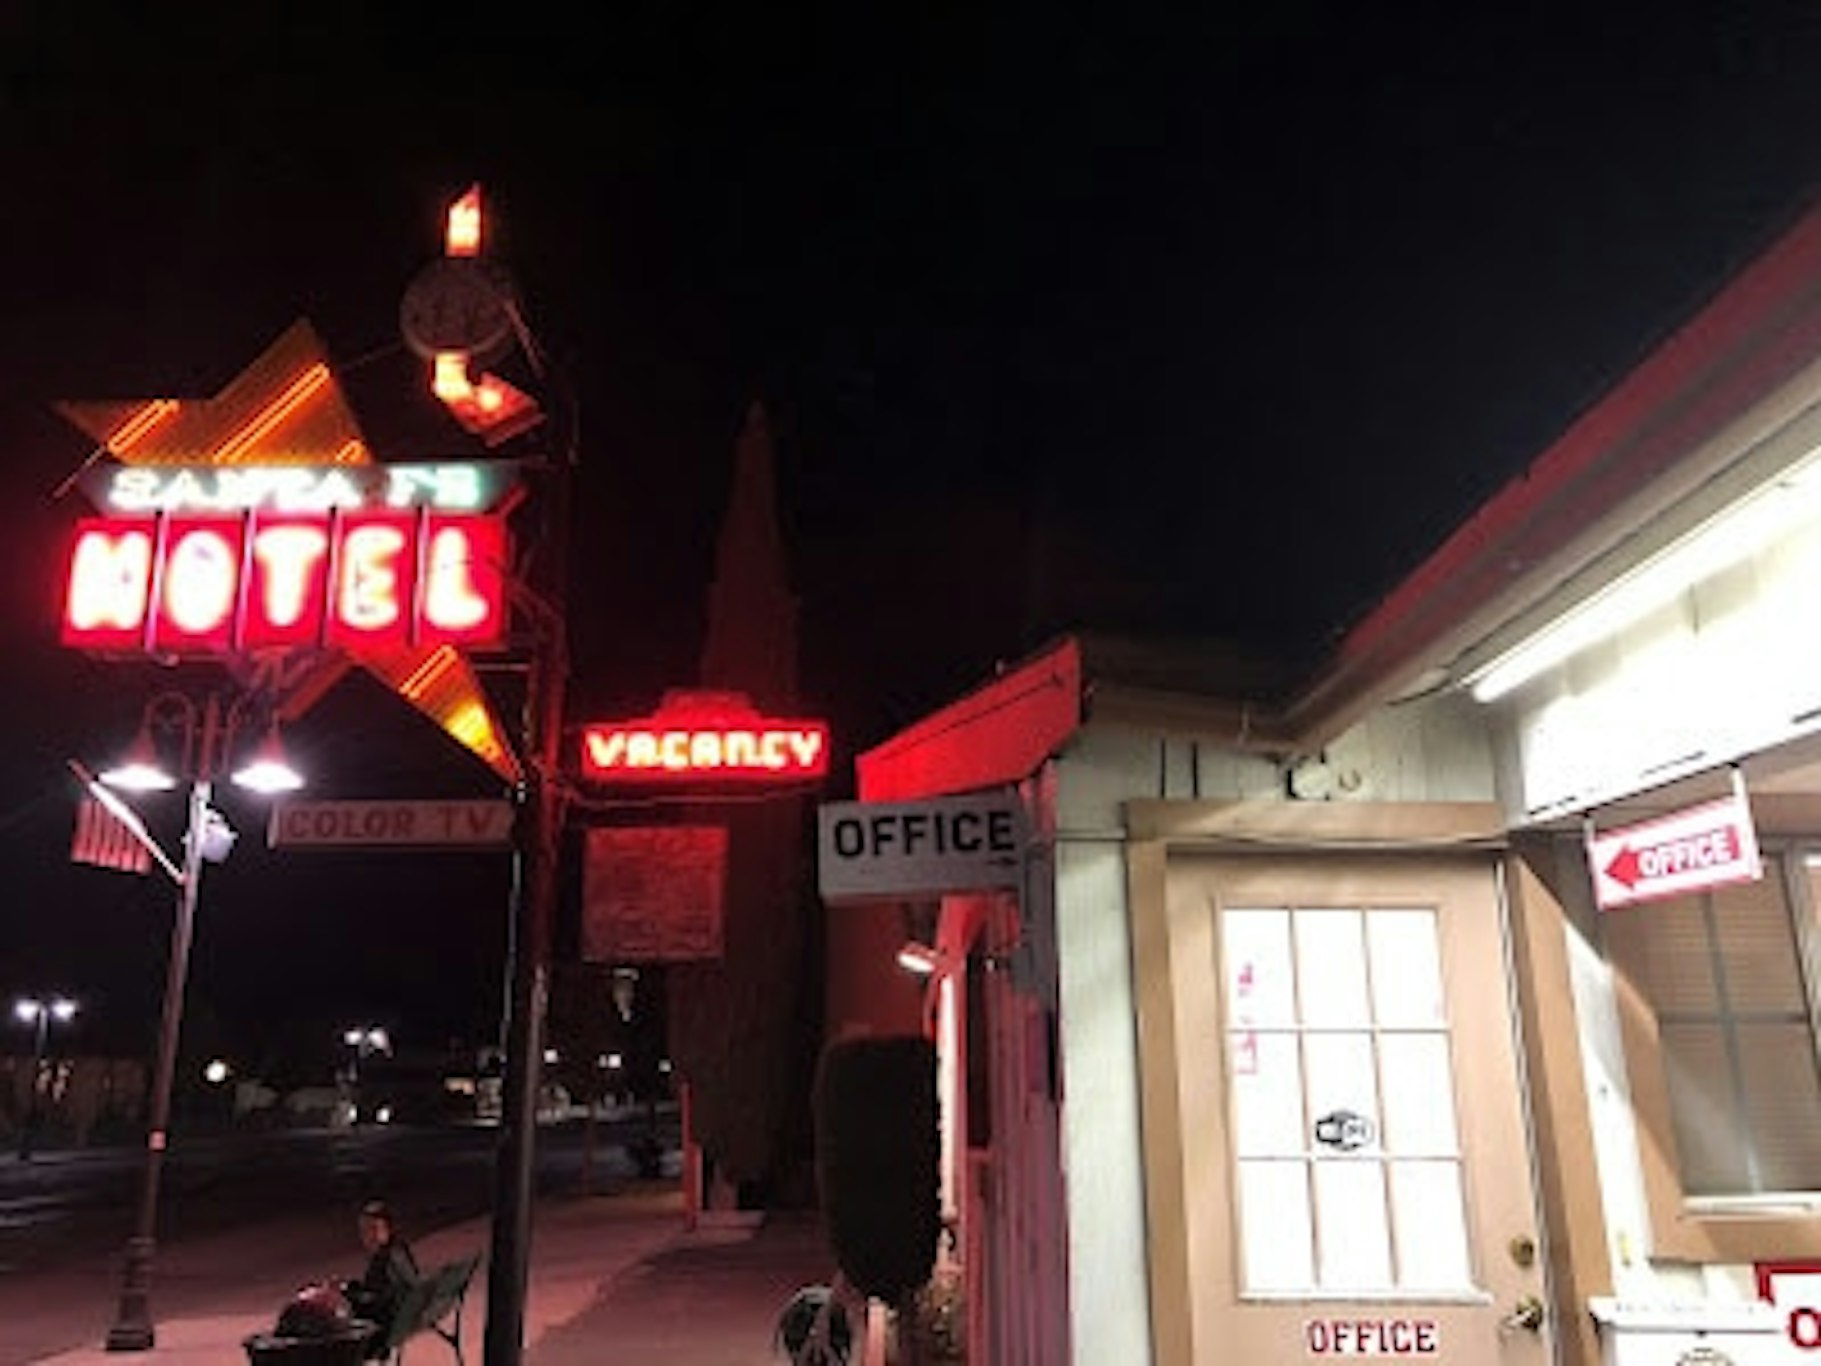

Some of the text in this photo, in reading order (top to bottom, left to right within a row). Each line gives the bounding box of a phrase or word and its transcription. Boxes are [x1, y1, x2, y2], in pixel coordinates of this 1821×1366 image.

[109, 466, 362, 507] SANTA
[70, 527, 487, 631] MOTEL
[589, 731, 821, 768] VACANCY
[287, 808, 495, 840] COLOR TV
[834, 811, 1015, 858] OFFICE
[1639, 829, 1733, 876] OFFICE
[1308, 1319, 1437, 1354] OFFICE
